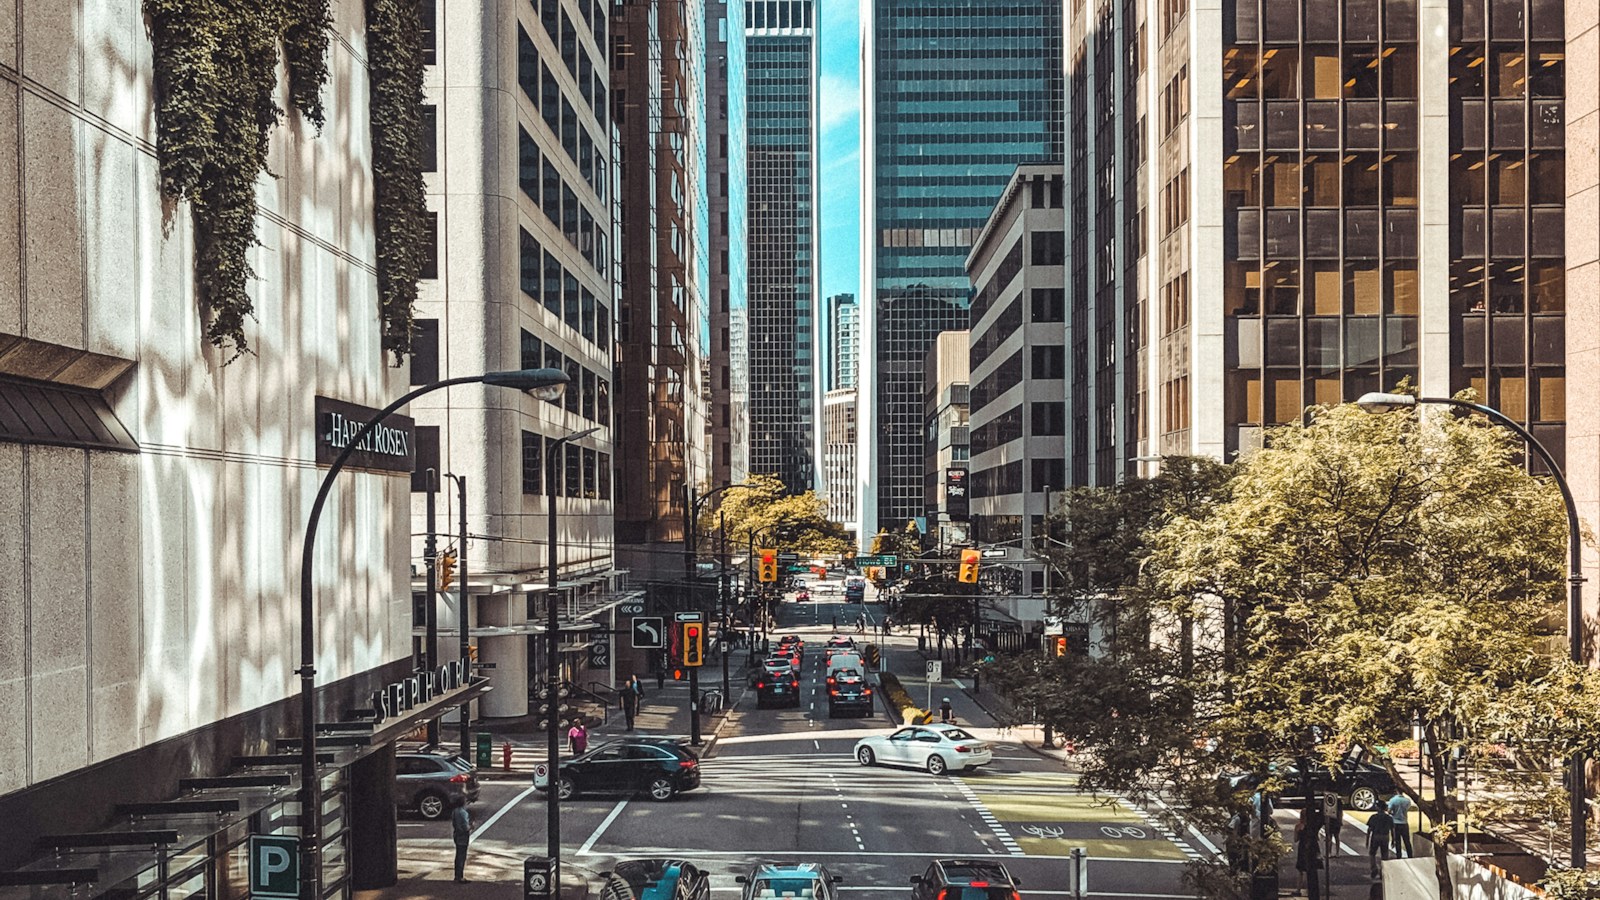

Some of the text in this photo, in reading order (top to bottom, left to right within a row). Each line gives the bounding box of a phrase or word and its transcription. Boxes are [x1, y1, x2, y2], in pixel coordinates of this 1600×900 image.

[374, 422, 409, 457] ROSEN
[883, 557, 894, 565] St
[260, 845, 290, 887] P
